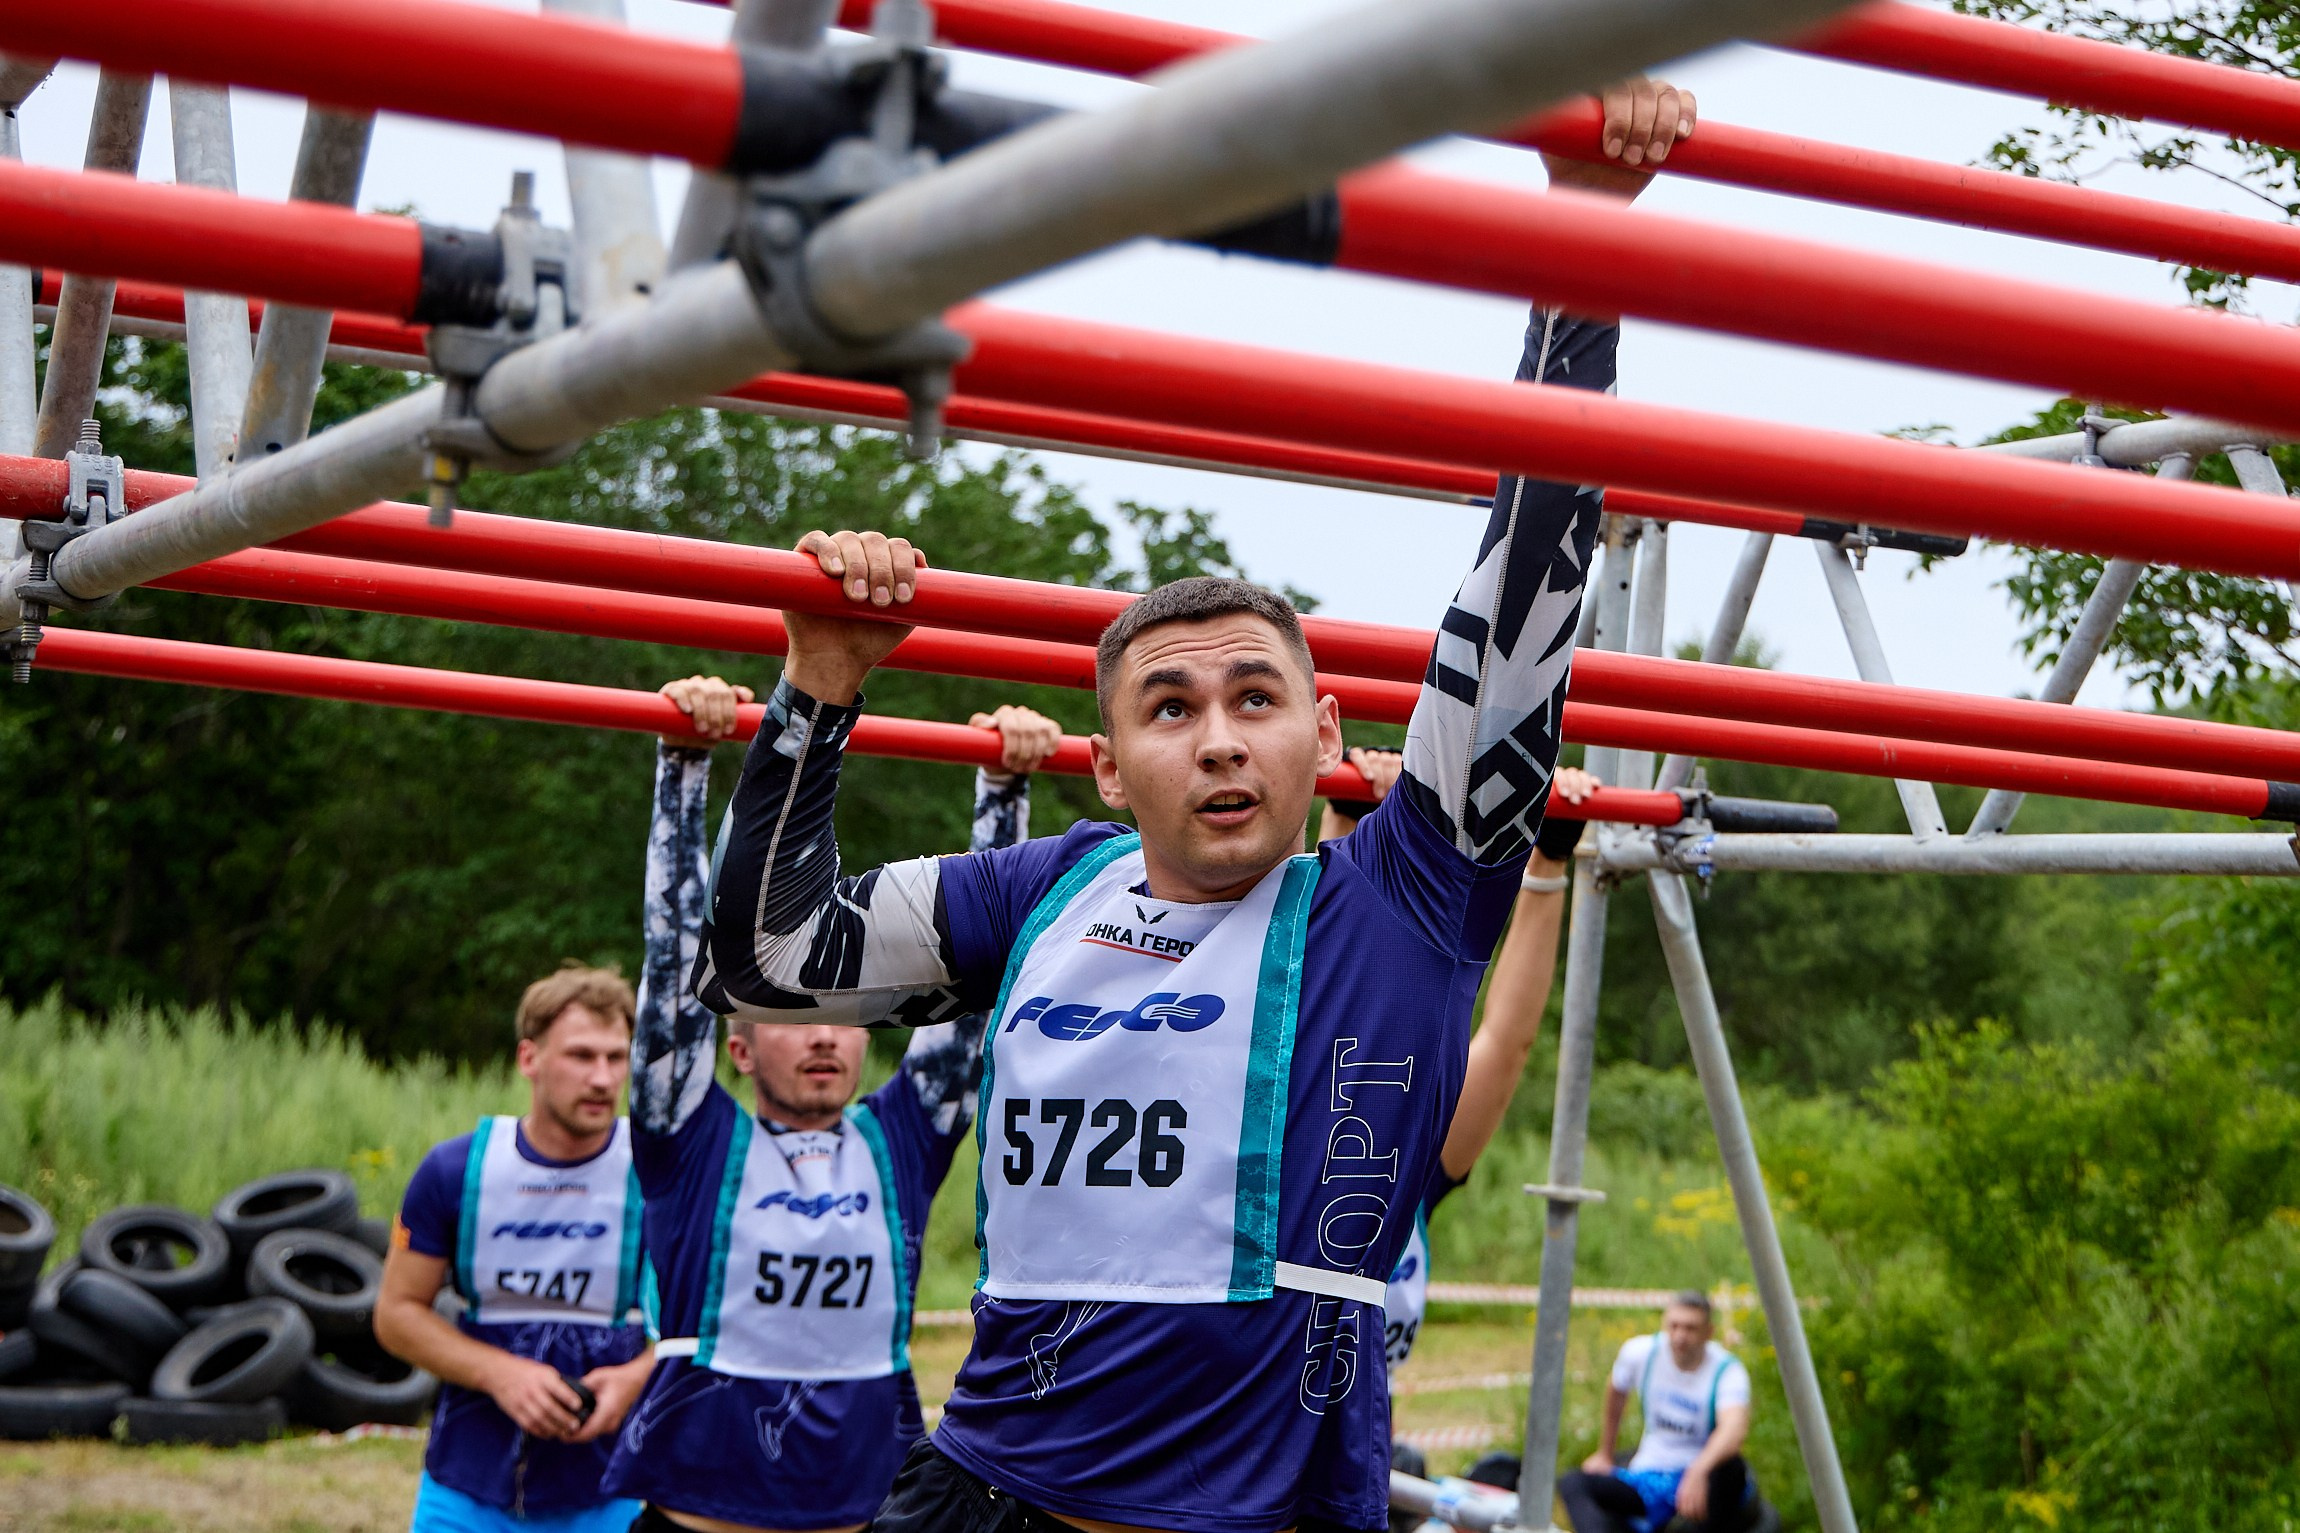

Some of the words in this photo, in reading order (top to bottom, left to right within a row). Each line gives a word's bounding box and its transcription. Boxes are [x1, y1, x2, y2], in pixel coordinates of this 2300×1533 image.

[1139, 932, 1200, 957] ГЕРО
[1004, 992, 1226, 1042] FESCO
[1002, 1097, 1188, 1188] 5726
[497, 1269, 592, 1307] 5747
[755, 1250, 873, 1308] 5727
